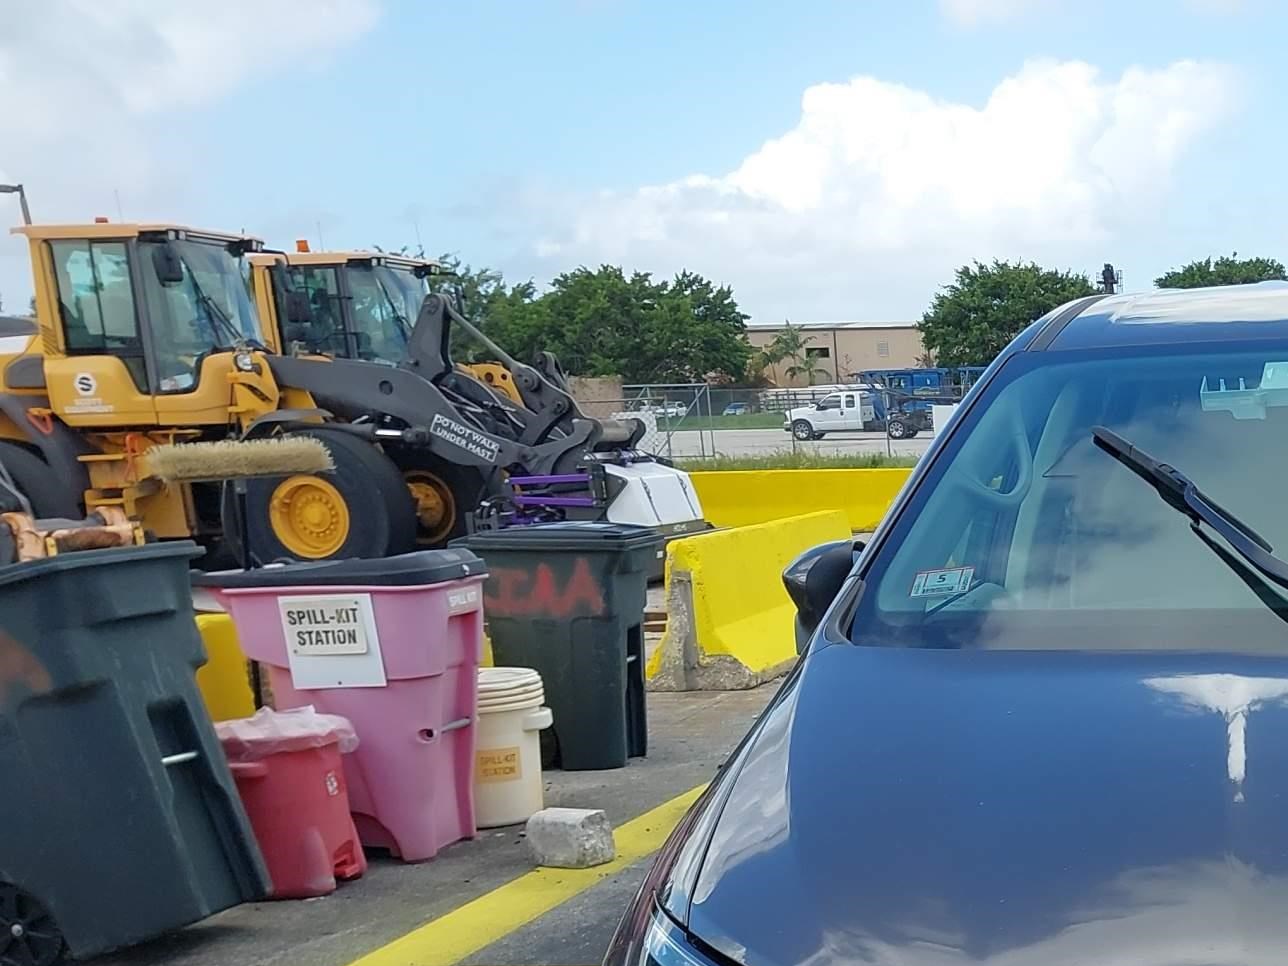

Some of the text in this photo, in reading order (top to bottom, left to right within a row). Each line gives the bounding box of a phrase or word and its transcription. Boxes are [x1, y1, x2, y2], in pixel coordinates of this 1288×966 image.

[437, 427, 492, 461] UNDER MAST
[450, 422, 471, 437] NOT
[471, 432, 499, 451] WALK
[286, 607, 358, 625] SPILL-KIT
[296, 629, 358, 646] STATION
